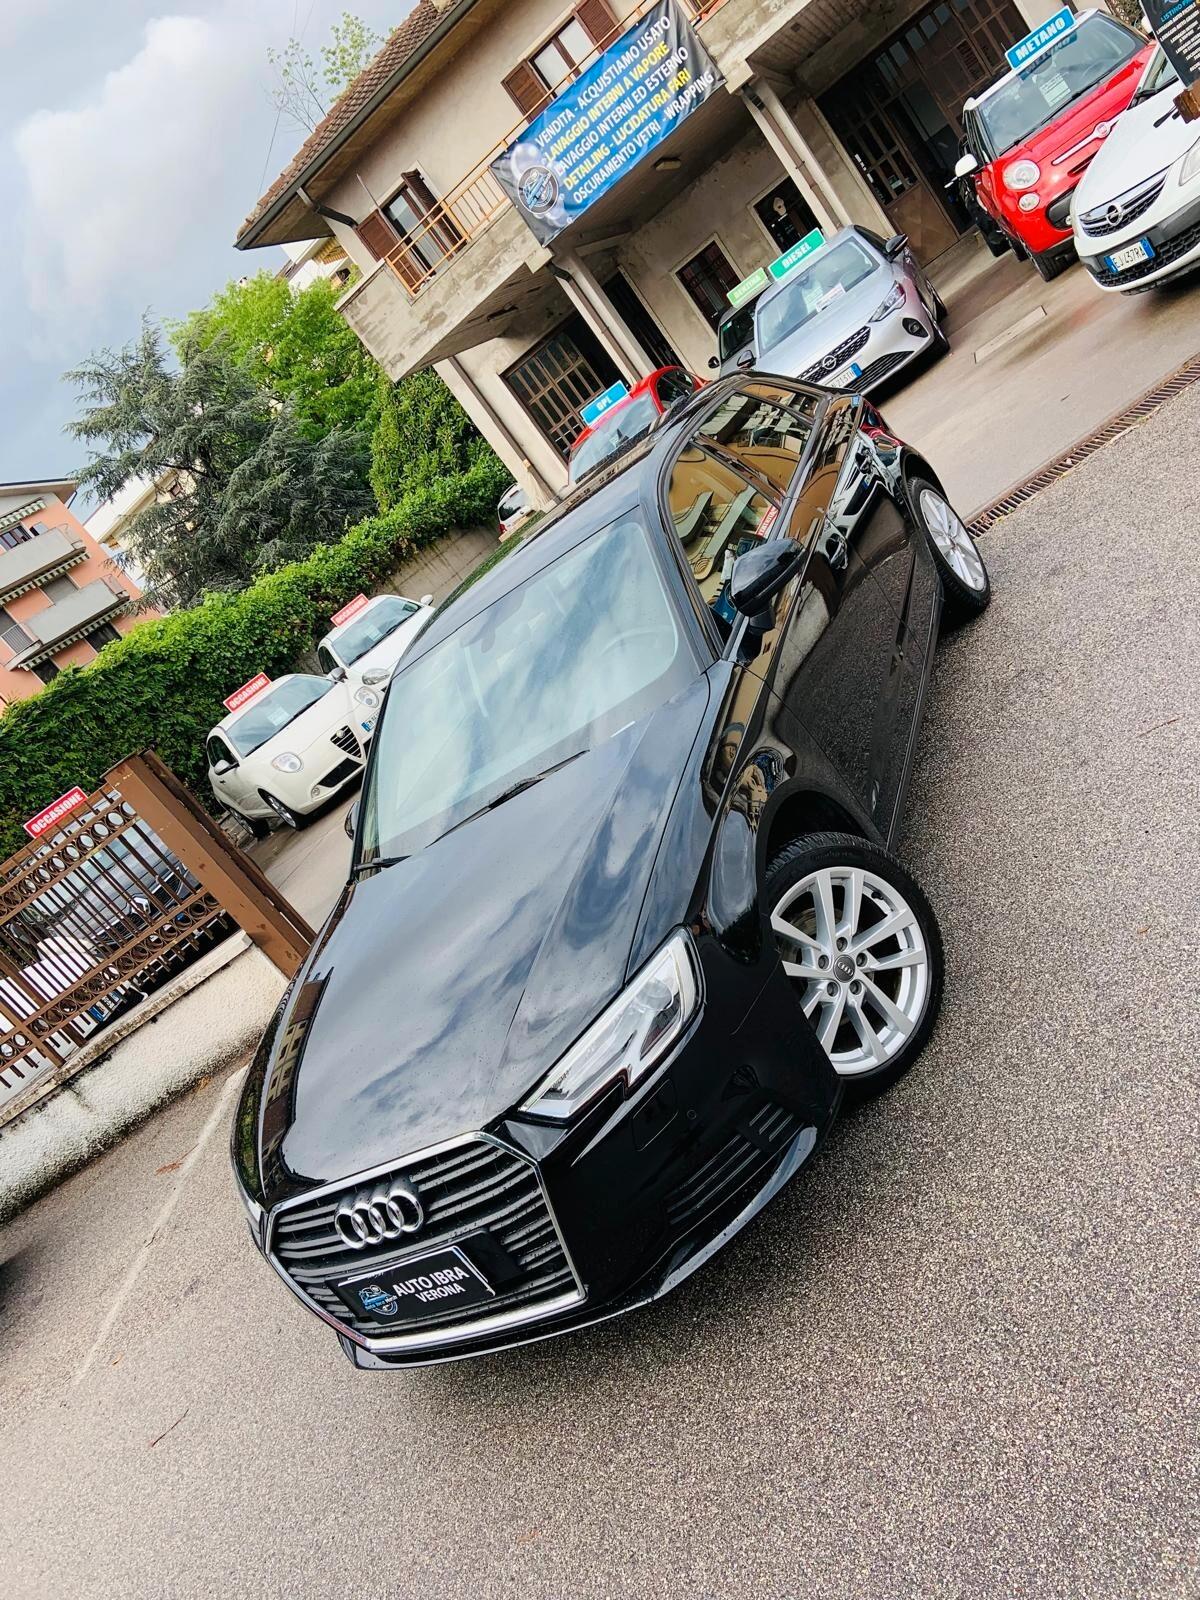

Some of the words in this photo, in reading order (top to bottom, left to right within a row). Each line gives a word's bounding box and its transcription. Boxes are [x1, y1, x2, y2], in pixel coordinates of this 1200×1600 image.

[1161, 4, 1182, 22] LISTINO
[1015, 16, 1067, 60] METANO
[535, 110, 575, 148] VENDITA
[577, 45, 640, 110] ACQUISTIAMO
[638, 15, 671, 51] USATO
[546, 118, 590, 161] LAVAGGIO
[588, 86, 626, 122] INTERNI
[623, 78, 633, 91] A
[630, 41, 670, 81] VAPORE
[554, 132, 599, 177] LAVAGGIO
[598, 100, 634, 137] INTERNI
[631, 89, 647, 106] ED
[646, 46, 690, 92] ESTERNO
[563, 143, 611, 191] DETAILING
[612, 90, 671, 145] LUCIDATURA
[668, 68, 692, 97] FARI
[573, 141, 637, 205] OSCURAMENTO
[633, 119, 662, 149] VETRI
[664, 70, 715, 121] WRAPPING
[781, 242, 812, 269] DIESEL
[229, 677, 267, 708] OCCASIONE
[31, 791, 83, 834] OCCASIONE
[392, 1277, 434, 1297] AUTO
[431, 1266, 469, 1285] IBRA
[415, 1283, 465, 1303] VERONA
